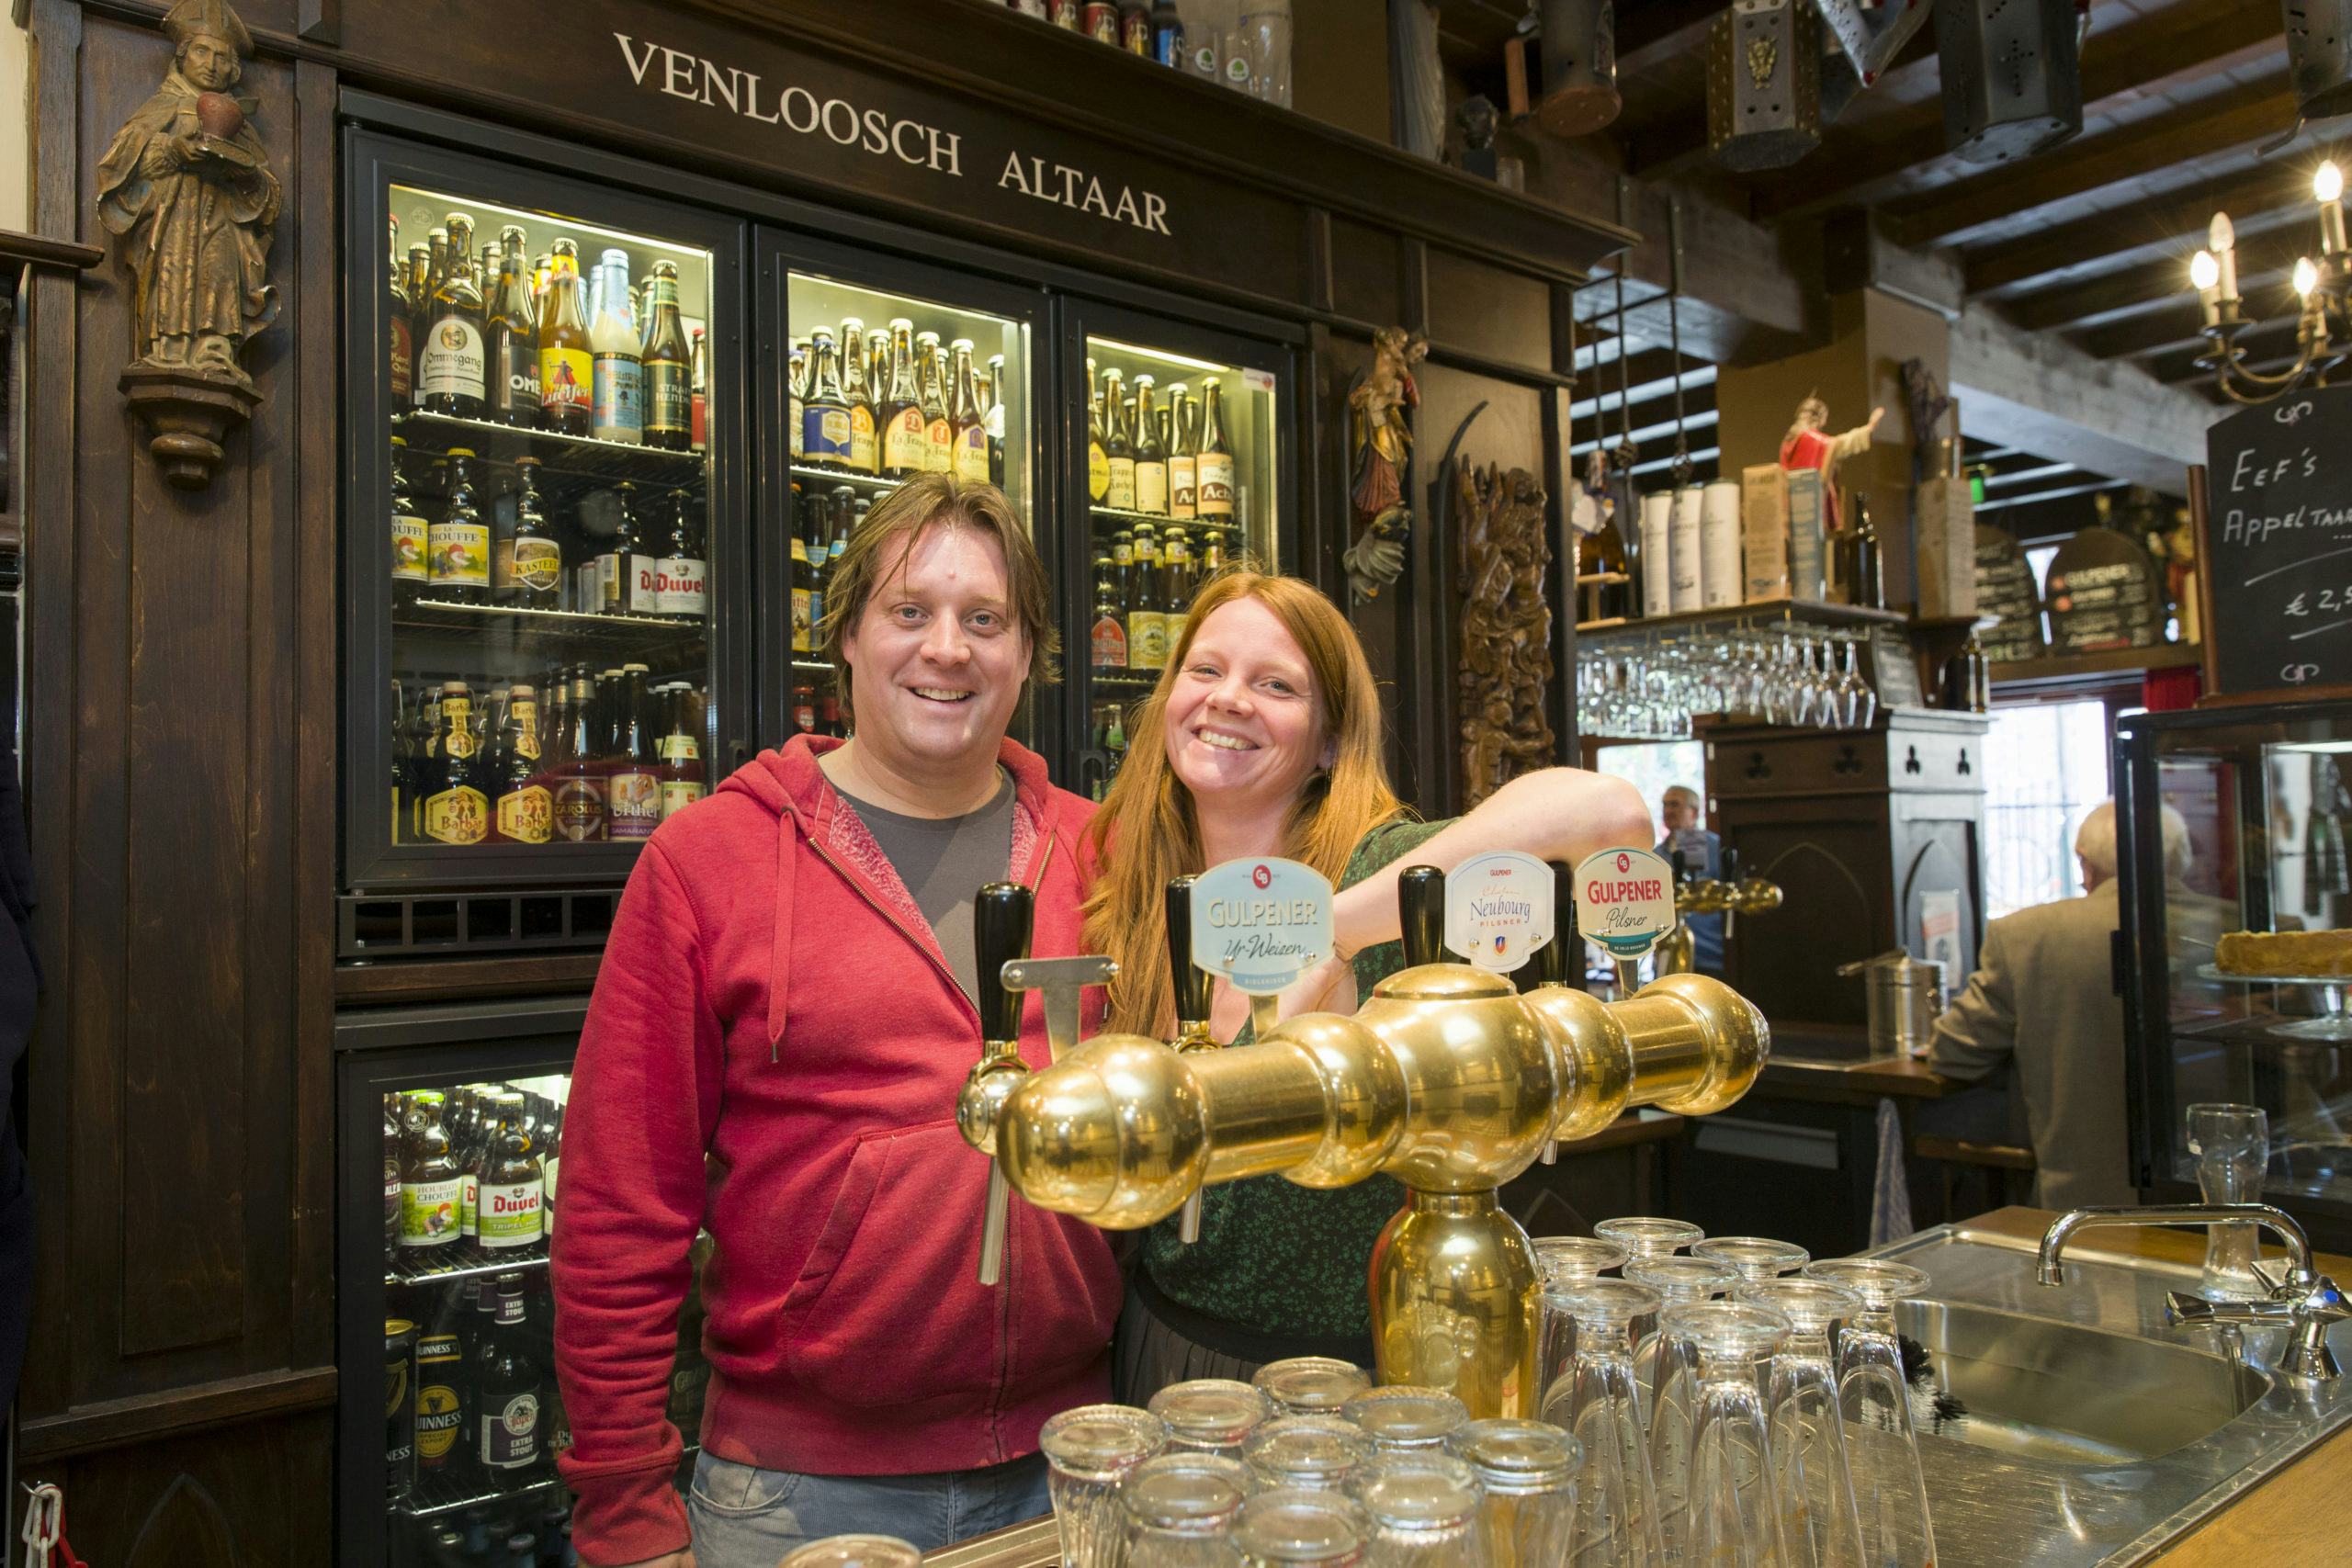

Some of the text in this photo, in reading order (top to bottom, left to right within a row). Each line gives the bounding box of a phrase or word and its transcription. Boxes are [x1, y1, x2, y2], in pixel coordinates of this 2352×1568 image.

[613, 33, 1172, 236] VENLOOSCH ALTAAR
[509, 373, 542, 397] OME
[1203, 484, 1231, 501] Ach
[391, 525, 424, 537] OUFFE
[430, 532, 478, 543] HOUFFE
[656, 572, 706, 594] Duvel
[611, 828, 652, 836] SAMARANT
[1587, 879, 1663, 905] GULPENER
[1207, 897, 1317, 928] GULPENER
[1470, 895, 1531, 923] Neubourg
[1479, 918, 1521, 928] PILSNER
[1606, 907, 1648, 931] Pilsner
[493, 1190, 539, 1213] Duvel
[419, 1343, 451, 1356] UINNESS
[418, 1412, 462, 1430] UINNESS
[510, 1434, 534, 1448] EXTRA
[386, 1444, 412, 1462] NESS
[510, 1444, 534, 1458] STOUT
